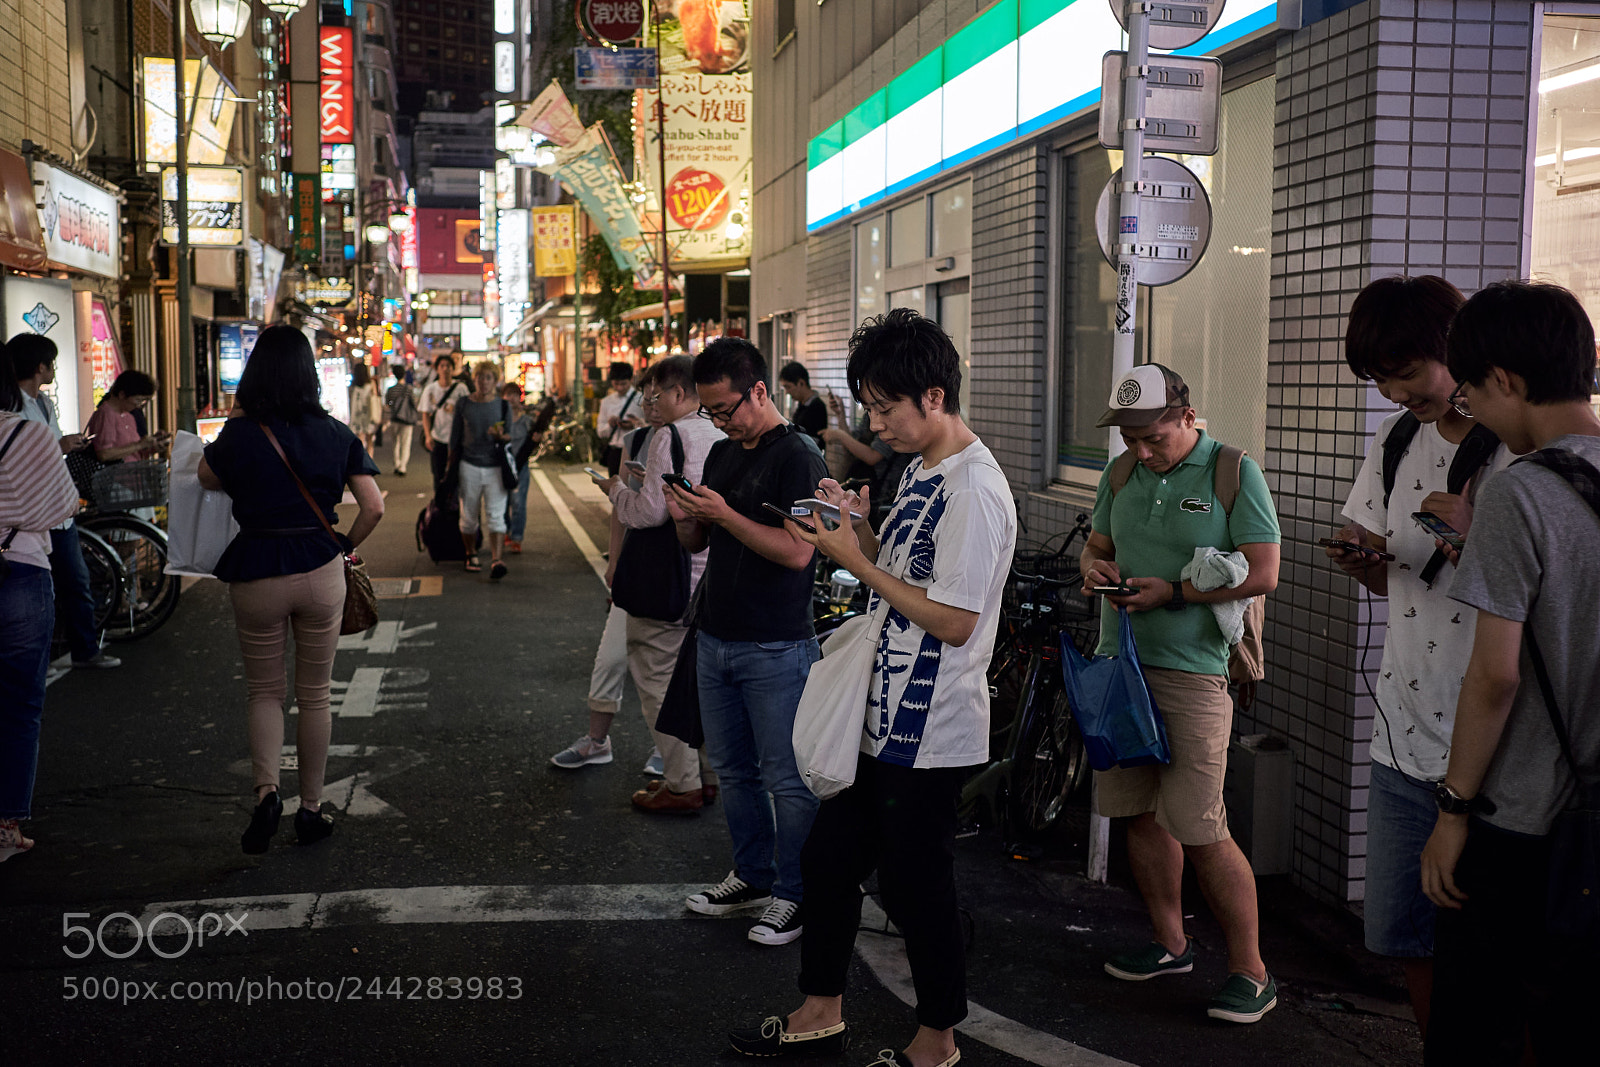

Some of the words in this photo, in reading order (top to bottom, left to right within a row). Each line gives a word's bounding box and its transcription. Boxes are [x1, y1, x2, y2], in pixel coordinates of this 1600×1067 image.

[591, 1, 640, 24] 消火栓
[320, 33, 350, 137] WINGS
[647, 75, 753, 95] ゃぶしゃぶ
[648, 99, 746, 123] 食べ放題
[658, 128, 740, 140] habu-Shabu
[658, 153, 685, 161] uffet
[687, 153, 700, 161] for
[704, 153, 711, 161] 2
[712, 153, 740, 161] hours
